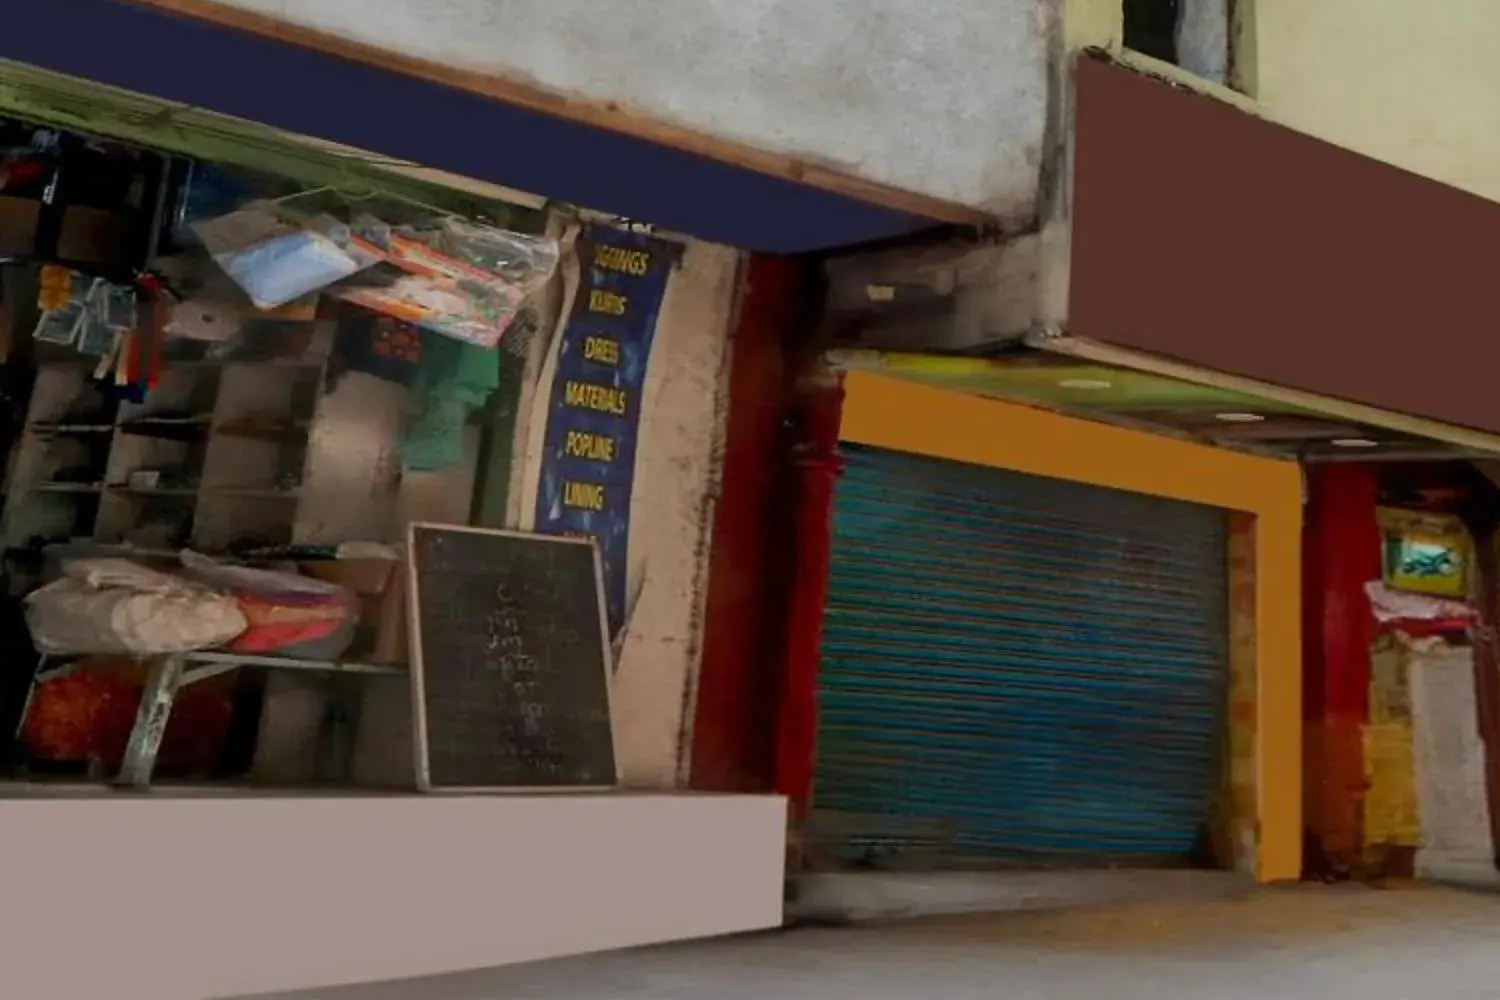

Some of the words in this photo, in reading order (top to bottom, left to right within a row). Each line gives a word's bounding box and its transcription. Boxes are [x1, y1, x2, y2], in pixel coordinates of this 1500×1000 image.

[565, 380, 627, 415] MATERIALS
[565, 431, 615, 462] POPLINE
[564, 481, 604, 511] LINING
